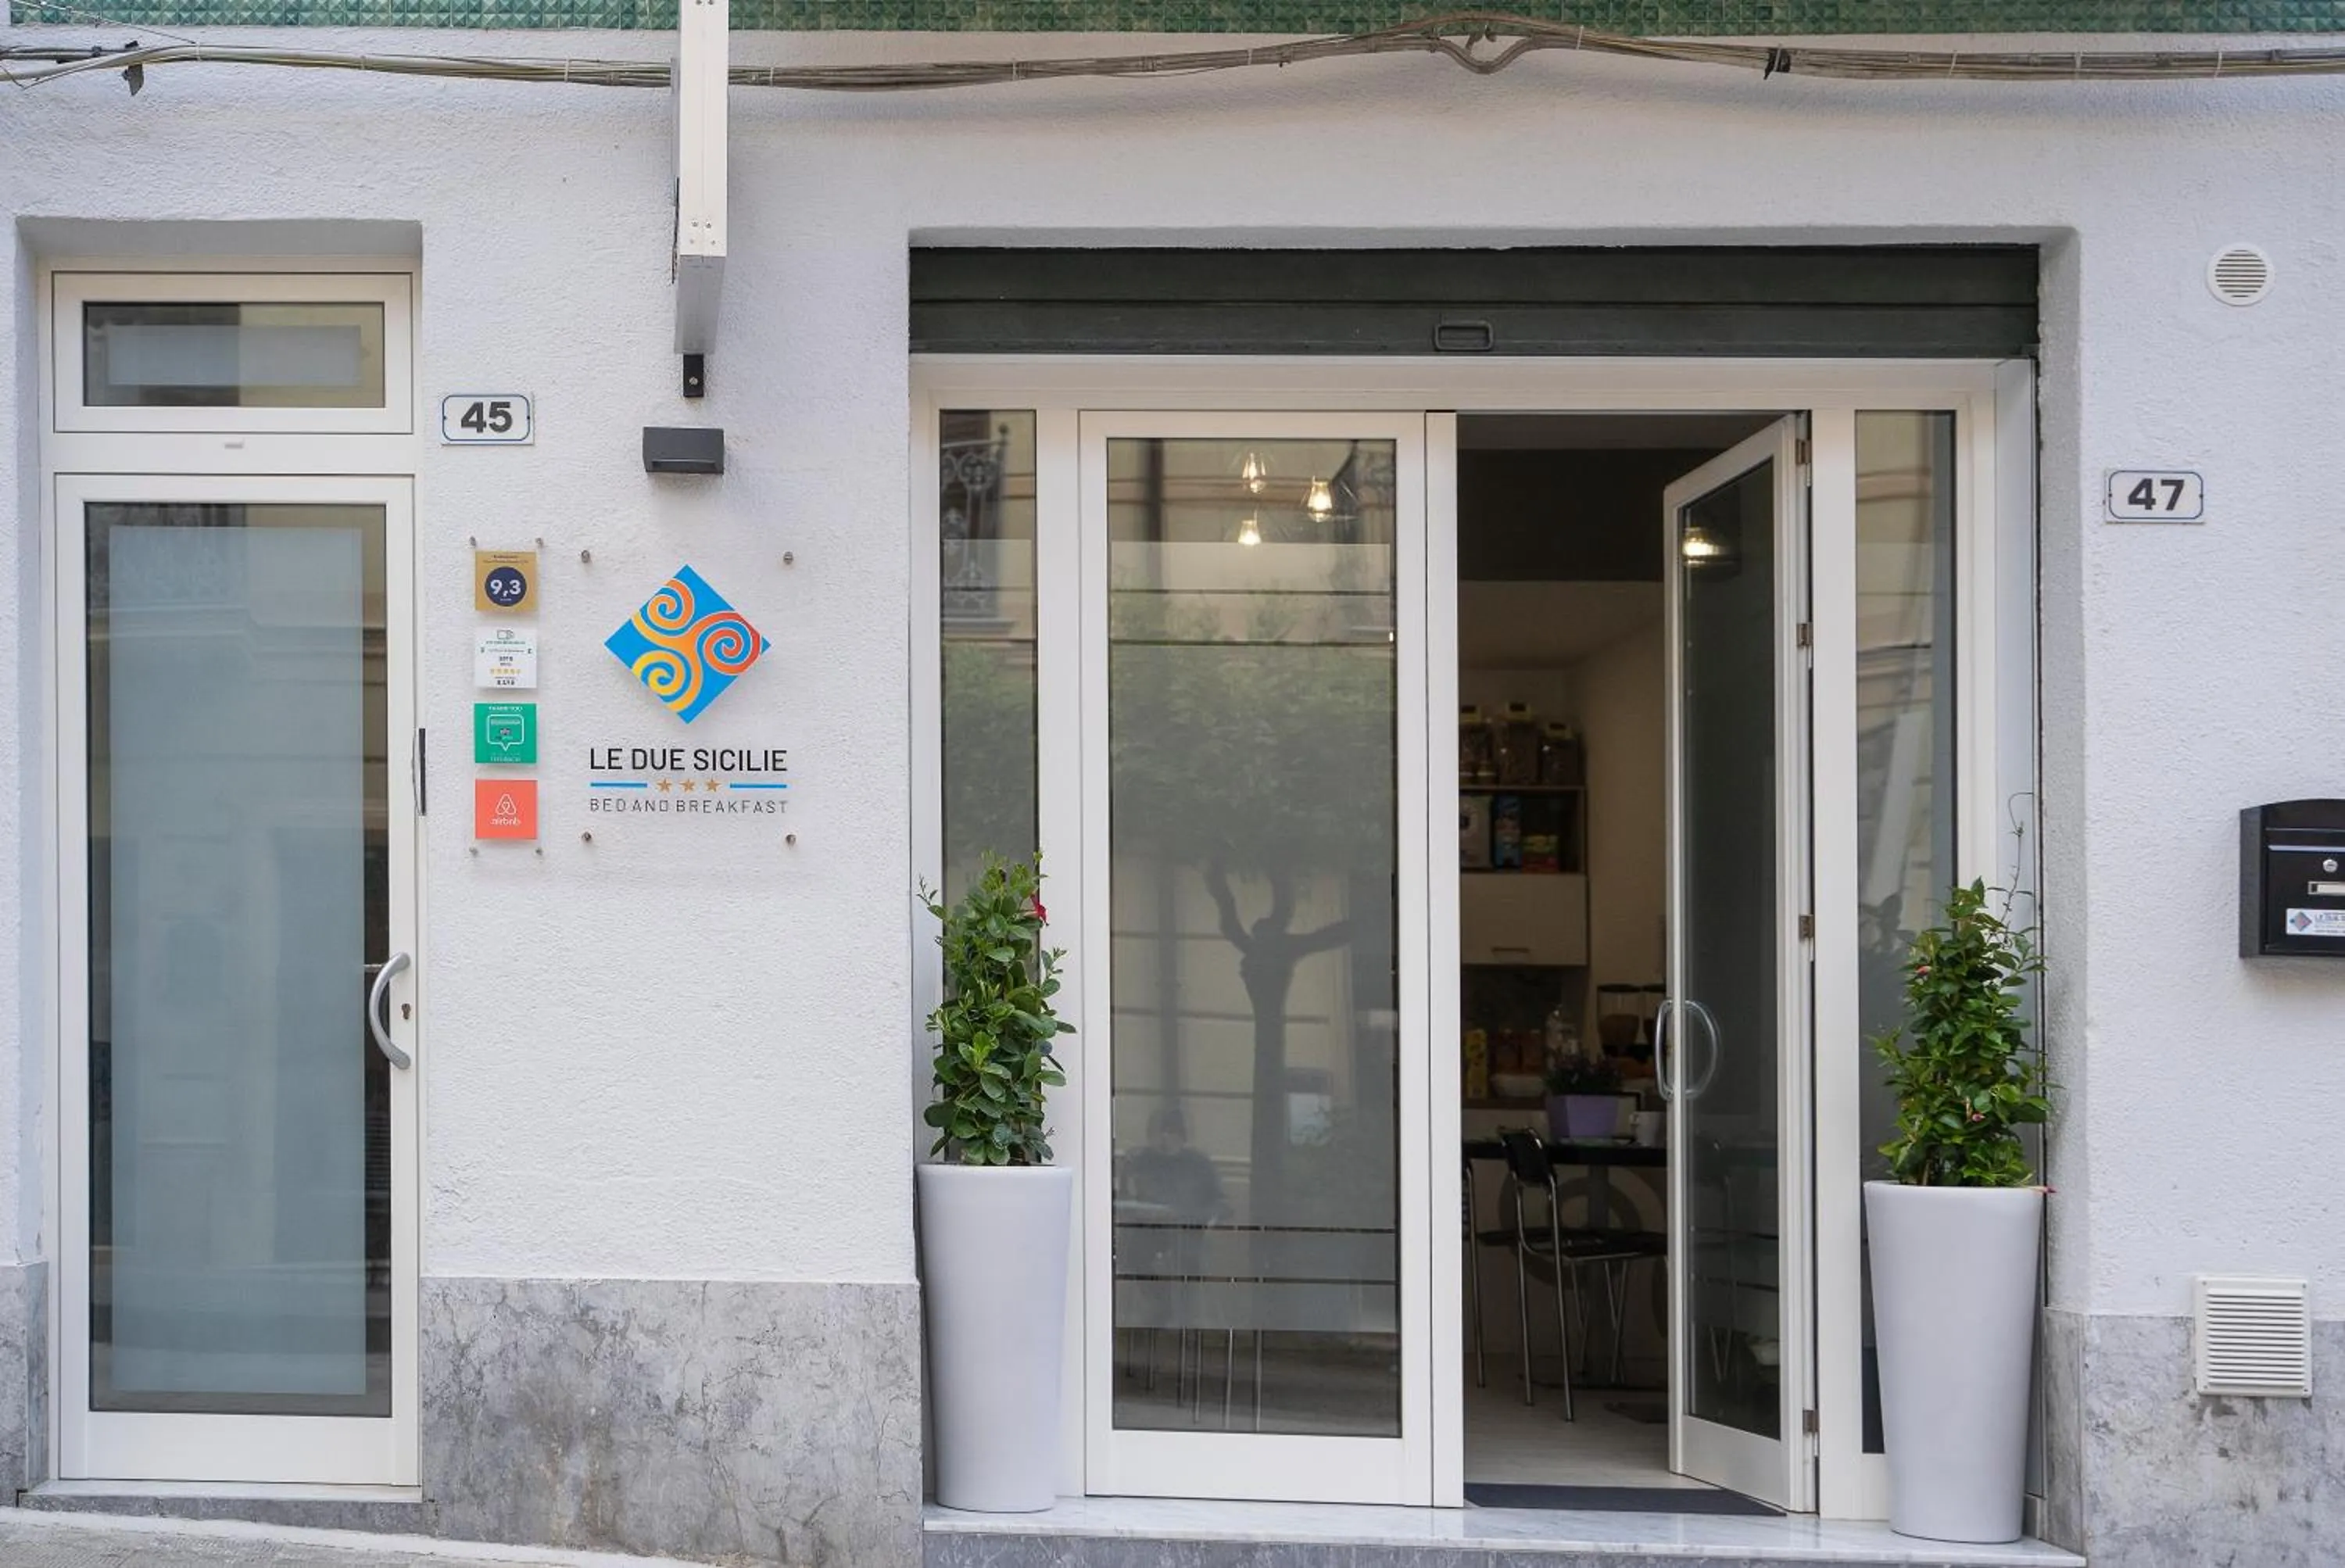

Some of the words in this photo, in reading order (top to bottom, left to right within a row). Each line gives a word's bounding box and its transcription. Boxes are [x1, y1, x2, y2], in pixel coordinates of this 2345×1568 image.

[460, 401, 513, 433] 45
[2128, 478, 2185, 510] 47
[490, 579, 521, 597] 9,3
[590, 748, 623, 771] LE
[632, 748, 686, 771] DUE
[693, 749, 788, 771] SICILIE
[590, 798, 626, 812] BED
[632, 799, 670, 813] AND
[676, 800, 789, 814] BREAKFAST
